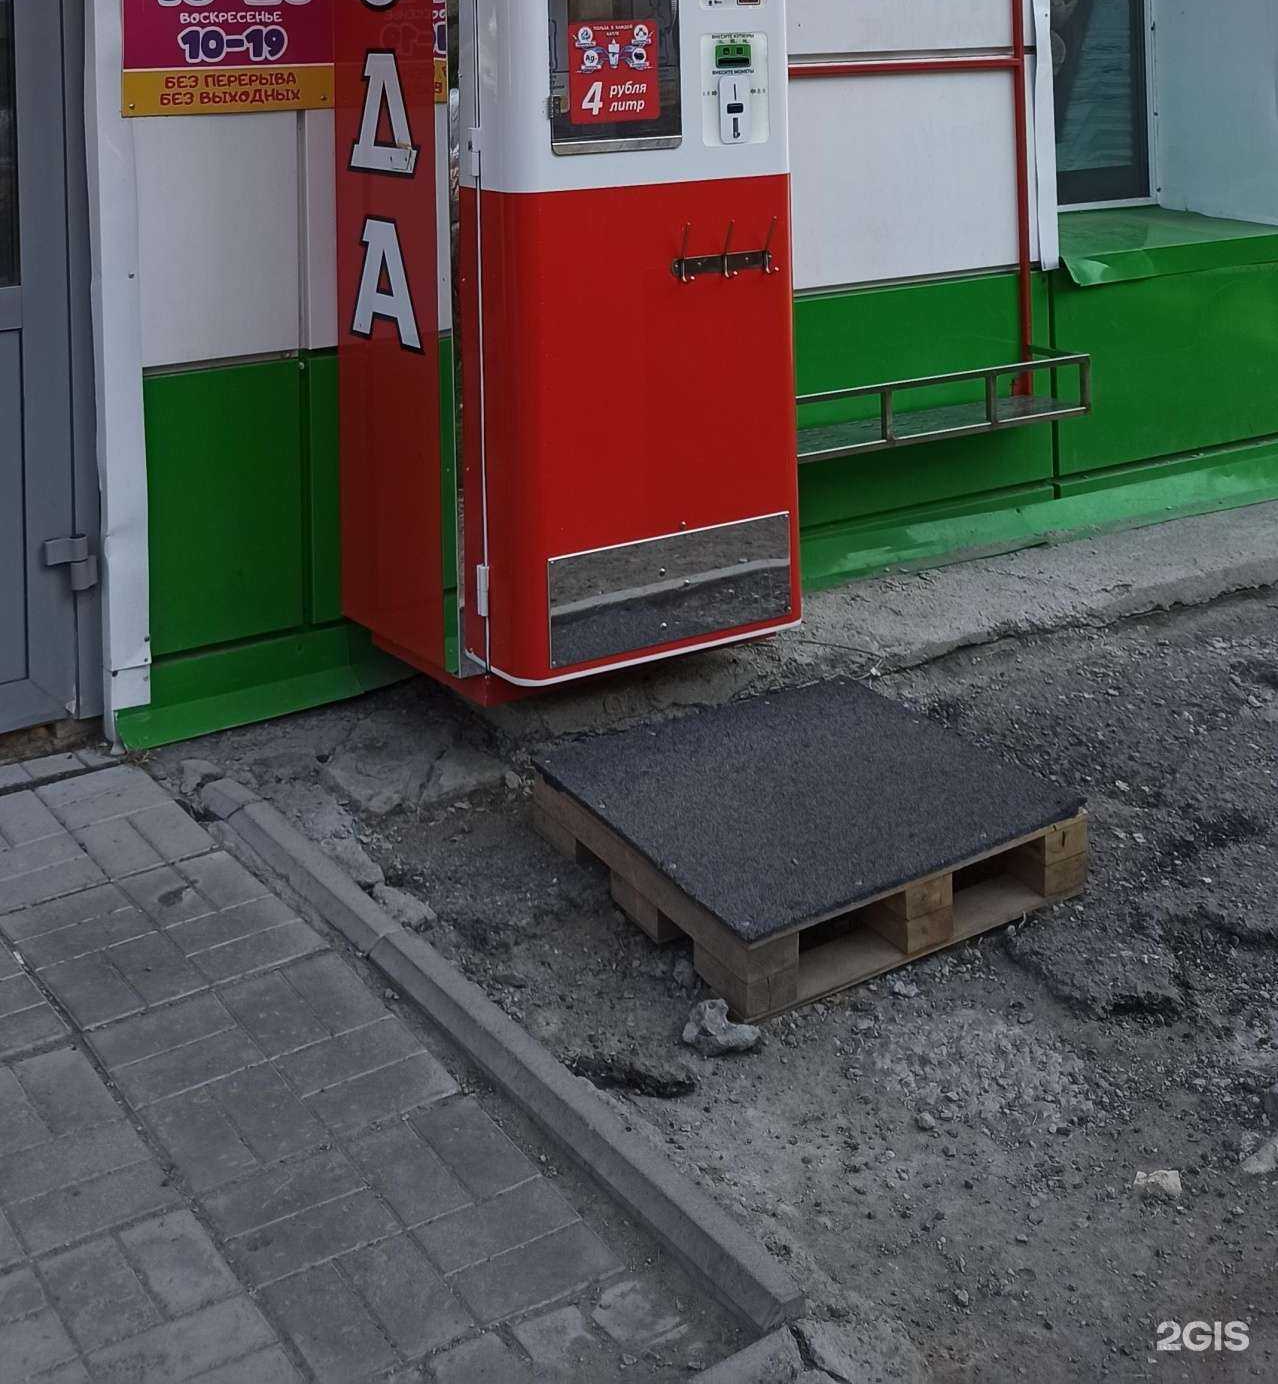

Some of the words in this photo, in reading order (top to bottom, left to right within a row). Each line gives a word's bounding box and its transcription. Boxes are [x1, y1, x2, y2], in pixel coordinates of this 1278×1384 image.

[179, 26, 287, 62] 10-19
[164, 74, 198, 88] БЕЗ
[204, 72, 297, 88] ПЕРЕРЫВА
[160, 91, 194, 106] БЕЗ
[200, 89, 300, 104] ВЫХОДНЫХ
[581, 81, 603, 115] 4
[610, 81, 647, 98] рубля
[609, 99, 645, 112] литр
